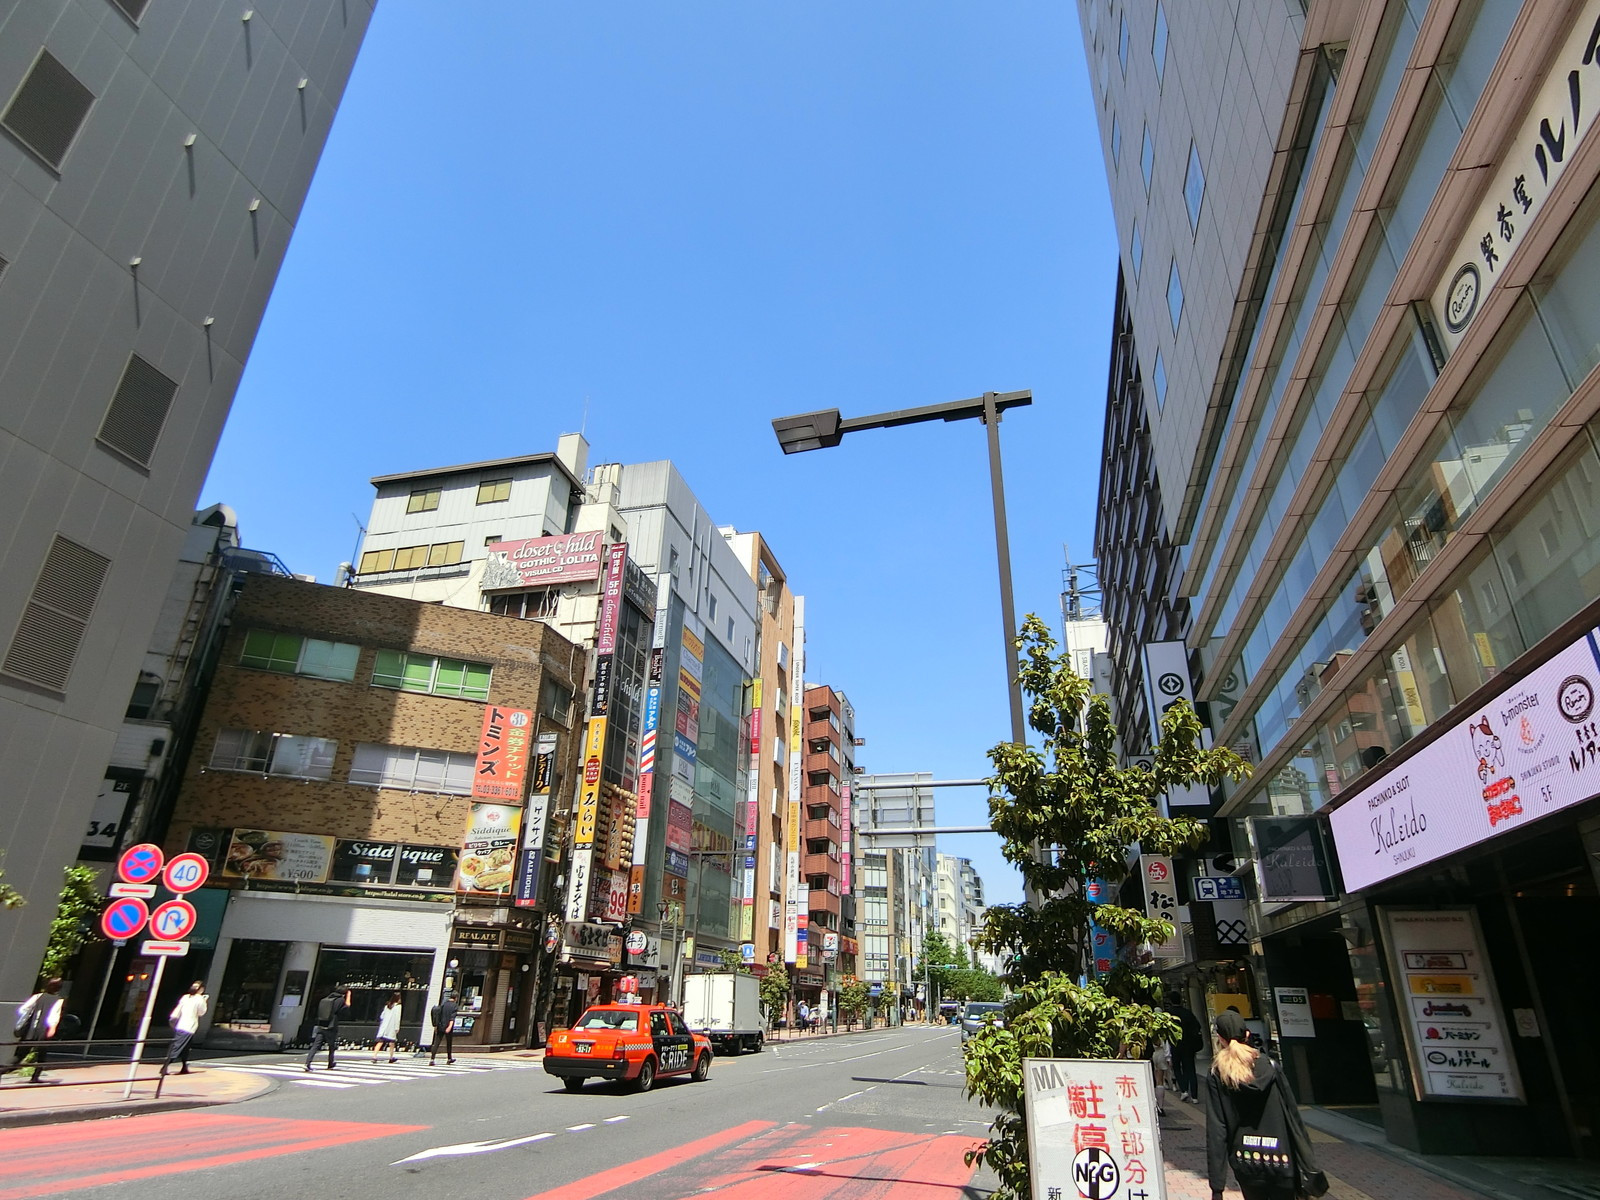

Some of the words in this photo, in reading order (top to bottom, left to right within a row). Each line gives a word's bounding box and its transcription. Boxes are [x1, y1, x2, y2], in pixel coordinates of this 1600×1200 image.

[1480, 174, 1532, 273] 喫茶室
[520, 556, 556, 569] GOTHIC
[560, 553, 598, 566] LOLITA
[612, 551, 623, 560] 6F
[524, 568, 551, 578] VISUAL
[552, 565, 564, 574] CD
[607, 588, 618, 596] CD
[608, 581, 620, 589] 5F
[1500, 693, 1540, 727] b-monster
[512, 713, 525, 726] 3F
[479, 707, 504, 776] トミンズ
[505, 727, 526, 779] 金券チケット
[1569, 740, 1600, 774] ルノア
[1542, 755, 1560, 772] STUDIO
[1367, 787, 1392, 811] PACHINKO
[1396, 775, 1410, 794] SLOT
[87, 821, 117, 838] 34
[470, 826, 511, 835] Siddique
[1370, 795, 1427, 855] Kaleido
[173, 865, 198, 882] 40
[523, 874, 532, 899] HOUSE
[570, 865, 585, 919] 富士そば
[458, 932, 480, 940] REAL
[481, 933, 497, 941] ALE
[1448, 1057, 1491, 1068] ルノアール
